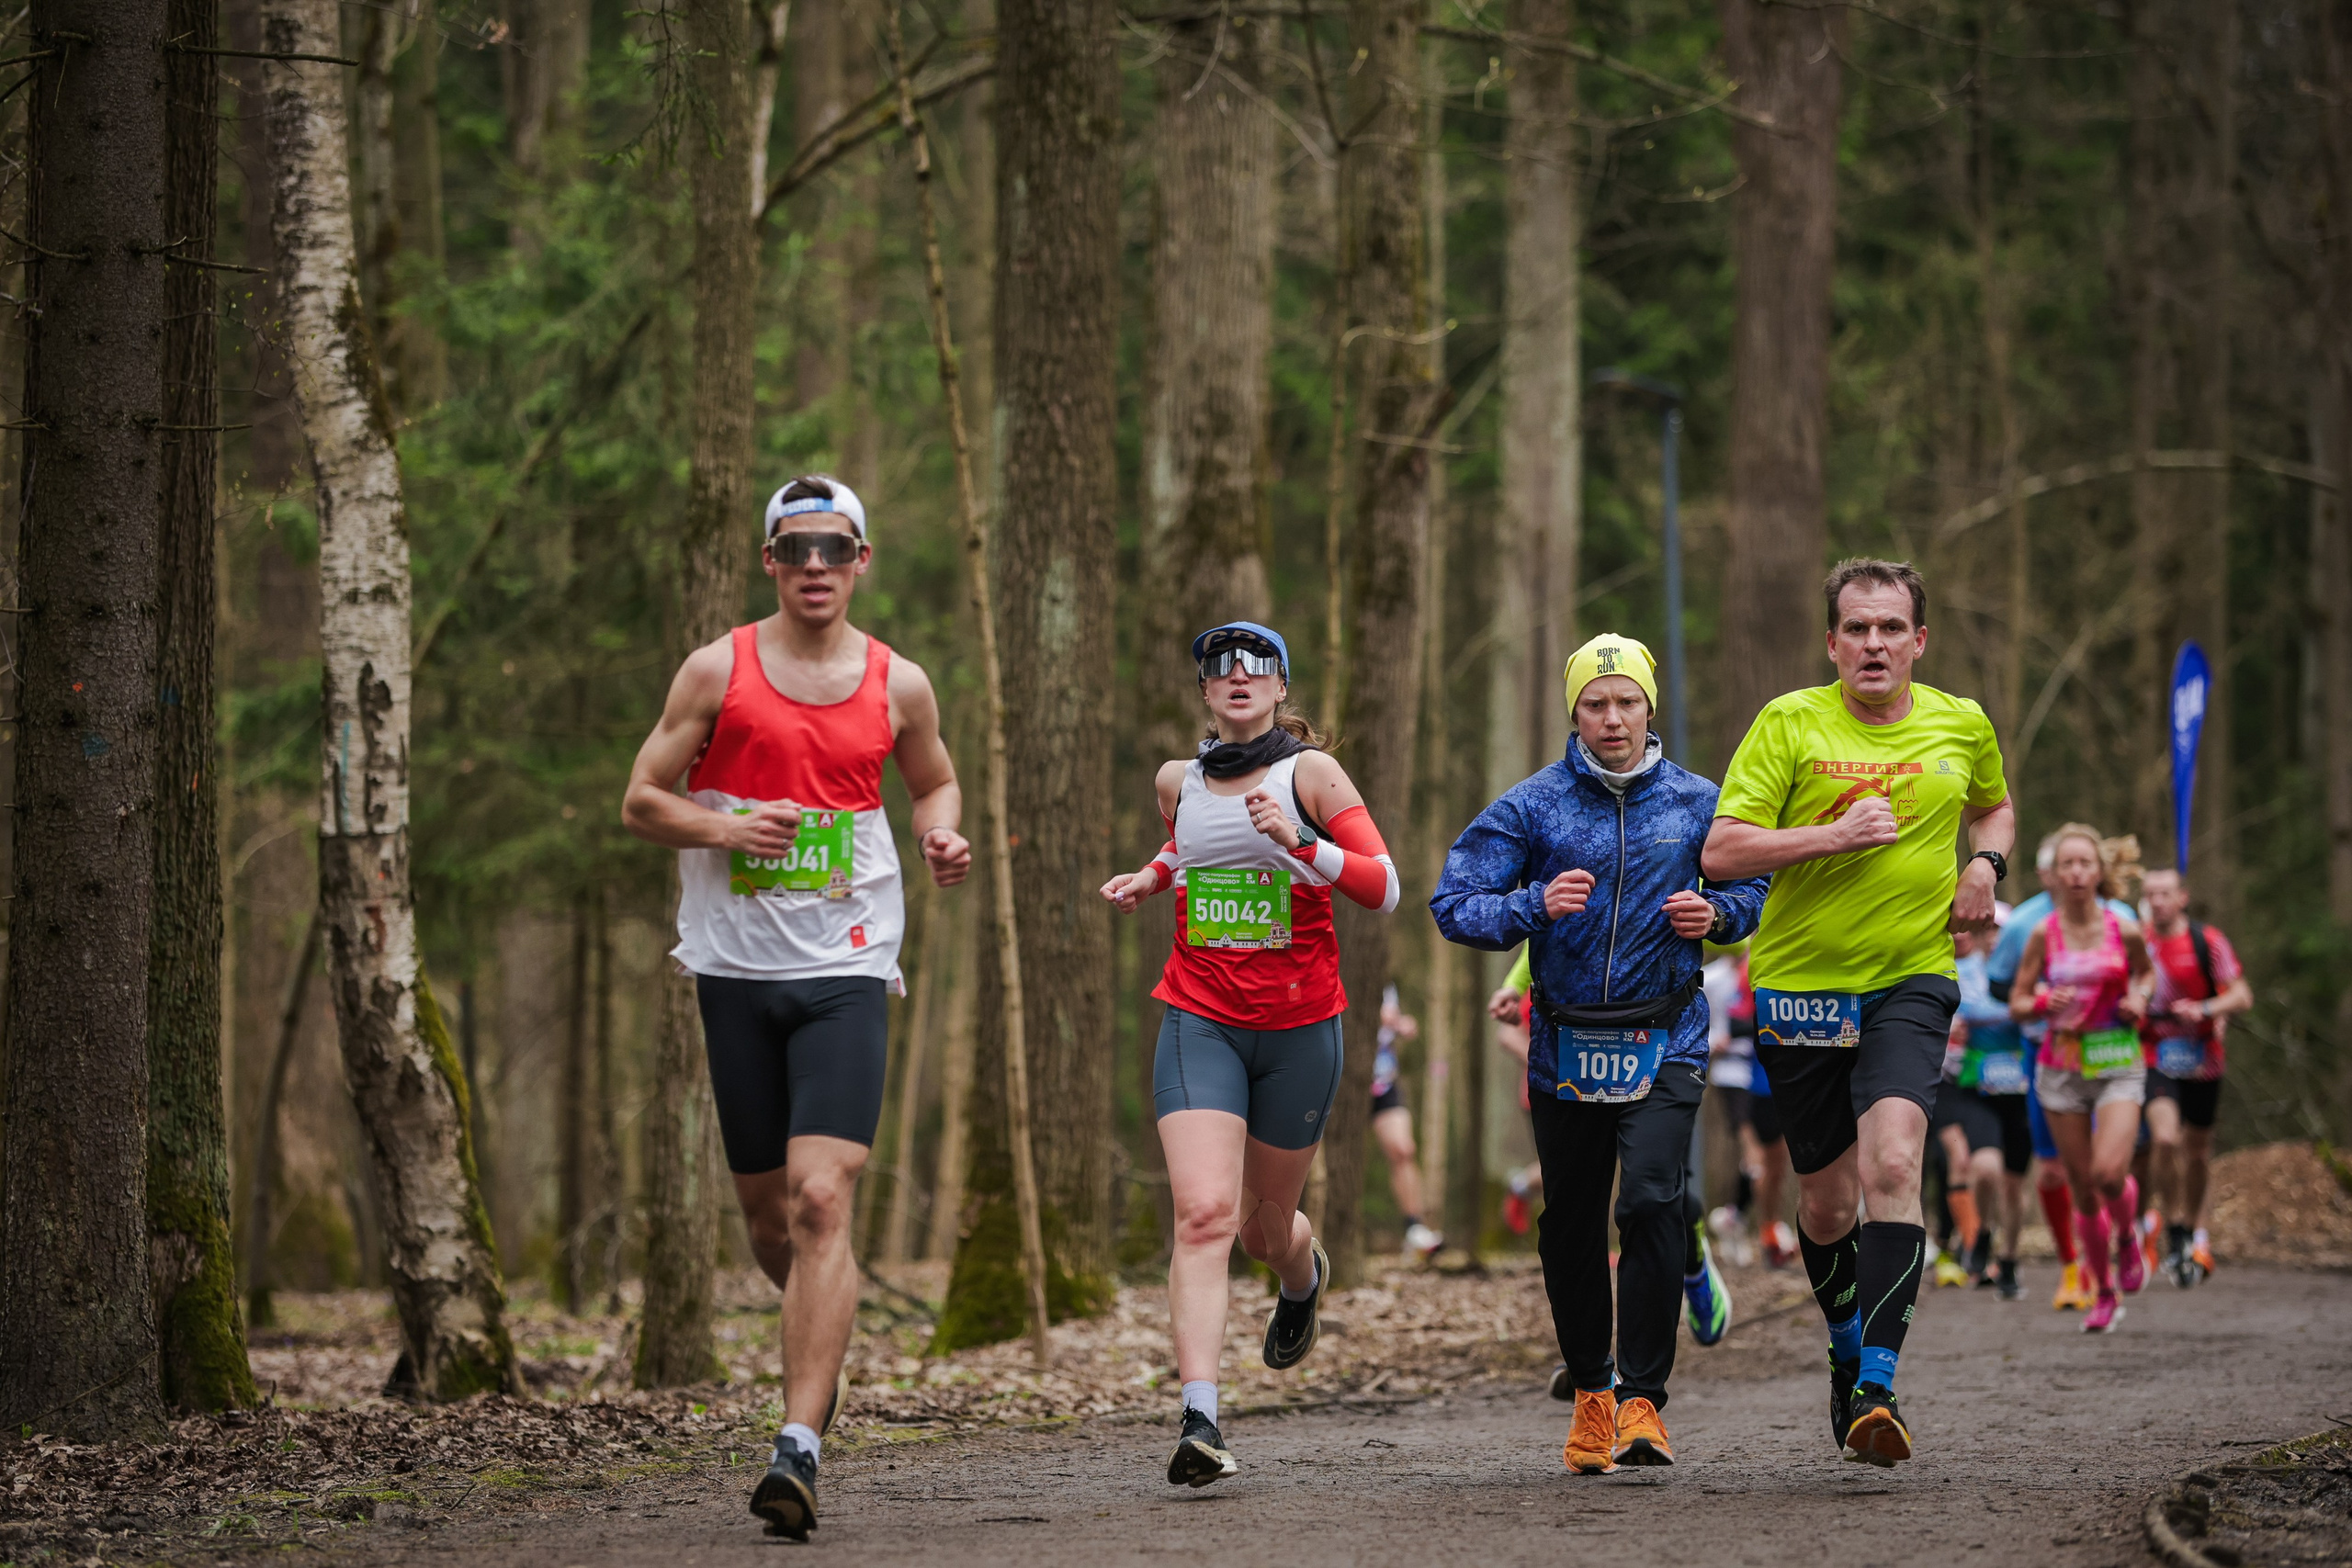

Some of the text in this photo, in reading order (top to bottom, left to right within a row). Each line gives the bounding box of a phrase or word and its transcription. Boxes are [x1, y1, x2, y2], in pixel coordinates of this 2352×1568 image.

[1597, 648, 1620, 657] BORN
[1601, 654, 1612, 663] TO
[1597, 661, 1615, 673] RUN
[1815, 762, 1899, 773] ЭНЕРГИЯ
[1195, 897, 1272, 924] 50042
[1768, 998, 1840, 1022] 10032
[1577, 1052, 1639, 1082] 1019
